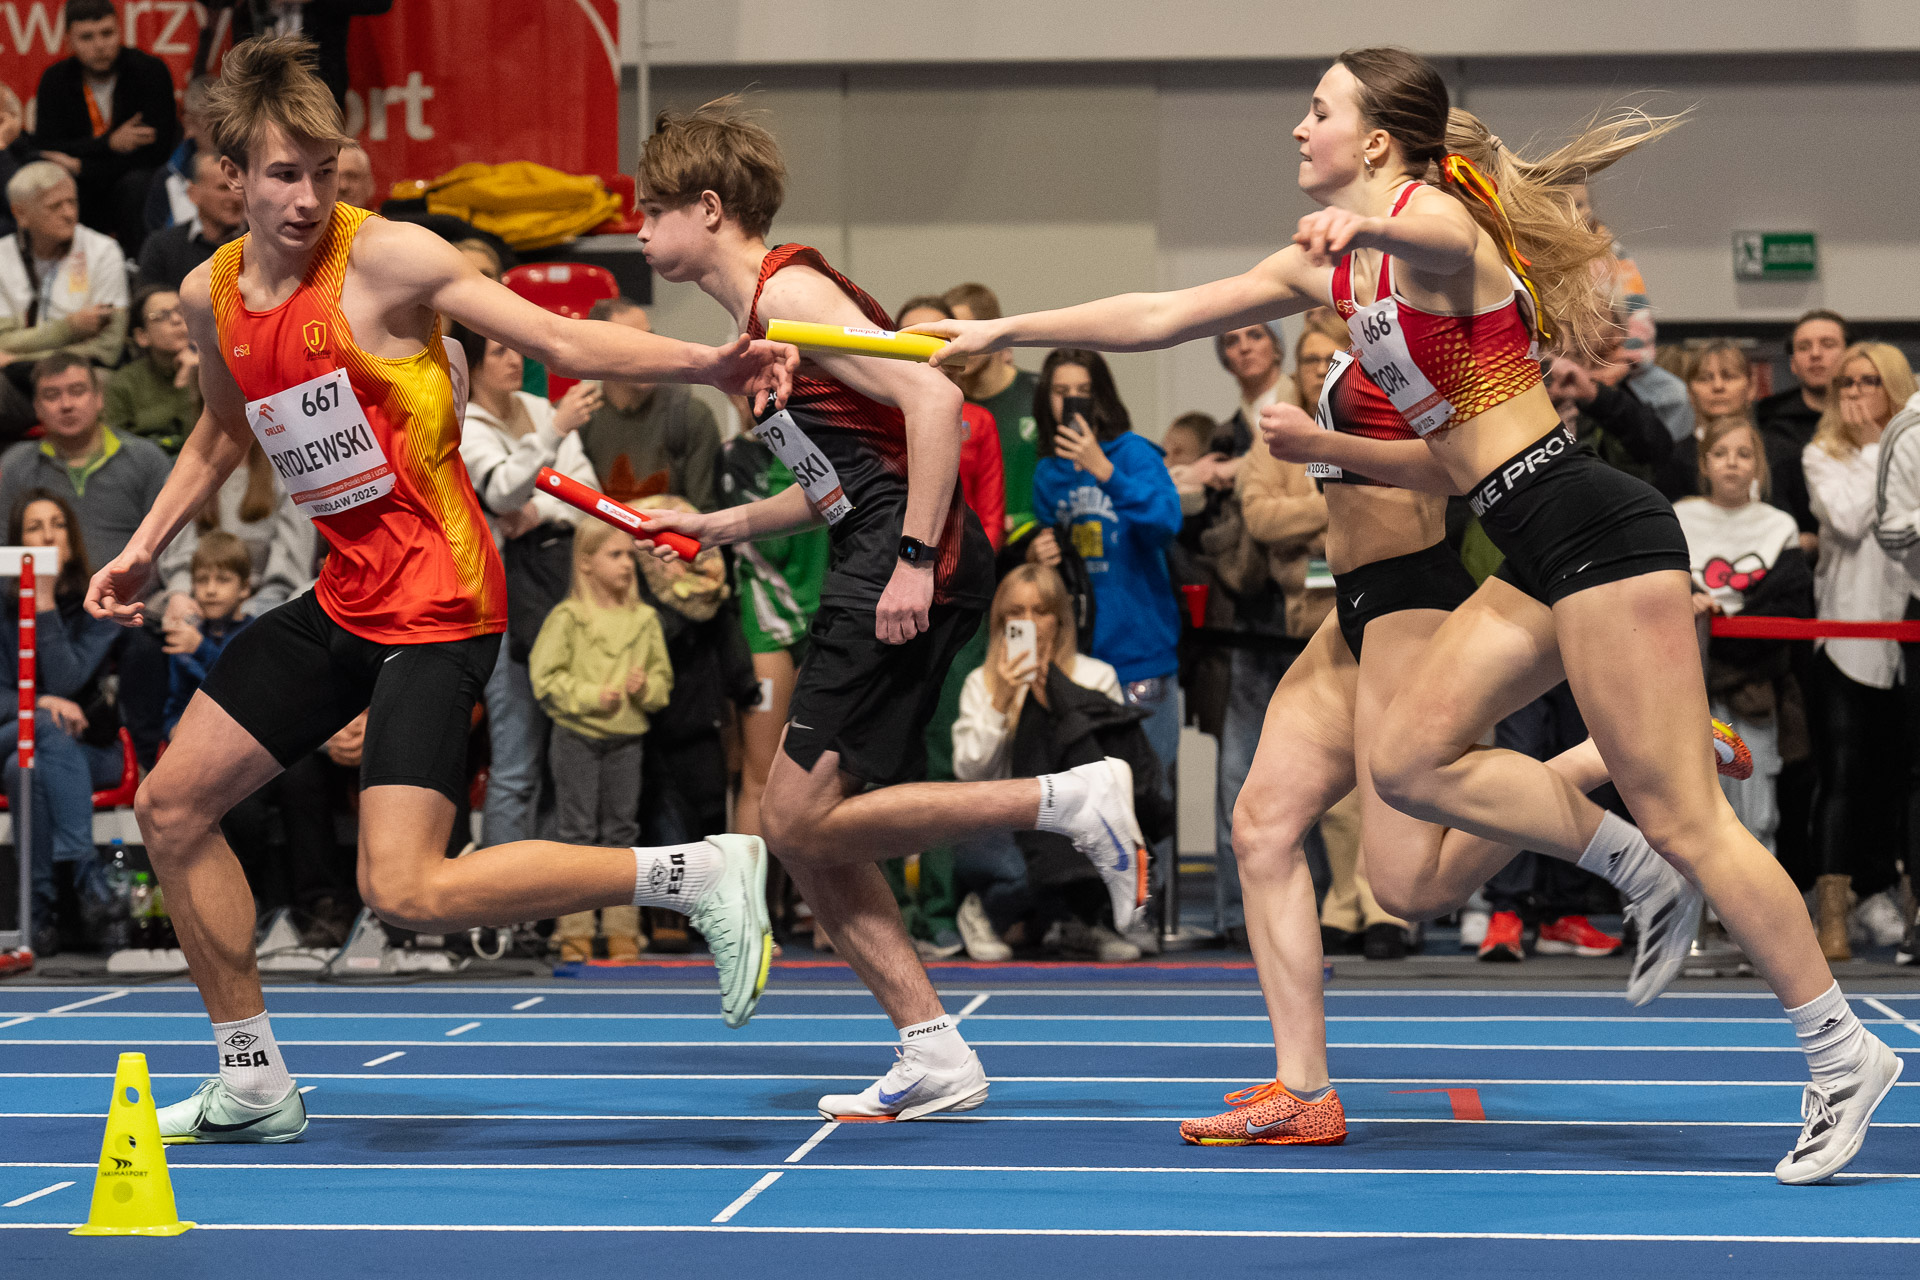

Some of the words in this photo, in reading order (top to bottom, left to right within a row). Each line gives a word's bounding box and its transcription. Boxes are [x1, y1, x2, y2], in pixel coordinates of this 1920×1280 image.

[310, 326, 320, 346] J
[1361, 311, 1392, 345] 668
[234, 344, 250, 358] esa
[302, 381, 338, 417] 667
[264, 424, 286, 436] ORLEN
[271, 424, 374, 478] RYDLEWSKI
[1502, 436, 1565, 490] PRO
[792, 452, 830, 488] SKI
[1311, 463, 1330, 474] 2025
[312, 496, 351, 514] WROCŁAW
[352, 486, 379, 502] 2025
[826, 504, 844, 521] 2025
[668, 853, 686, 894] ESA
[907, 1022, 949, 1038] O'NEILL
[224, 1050, 270, 1067] ESA
